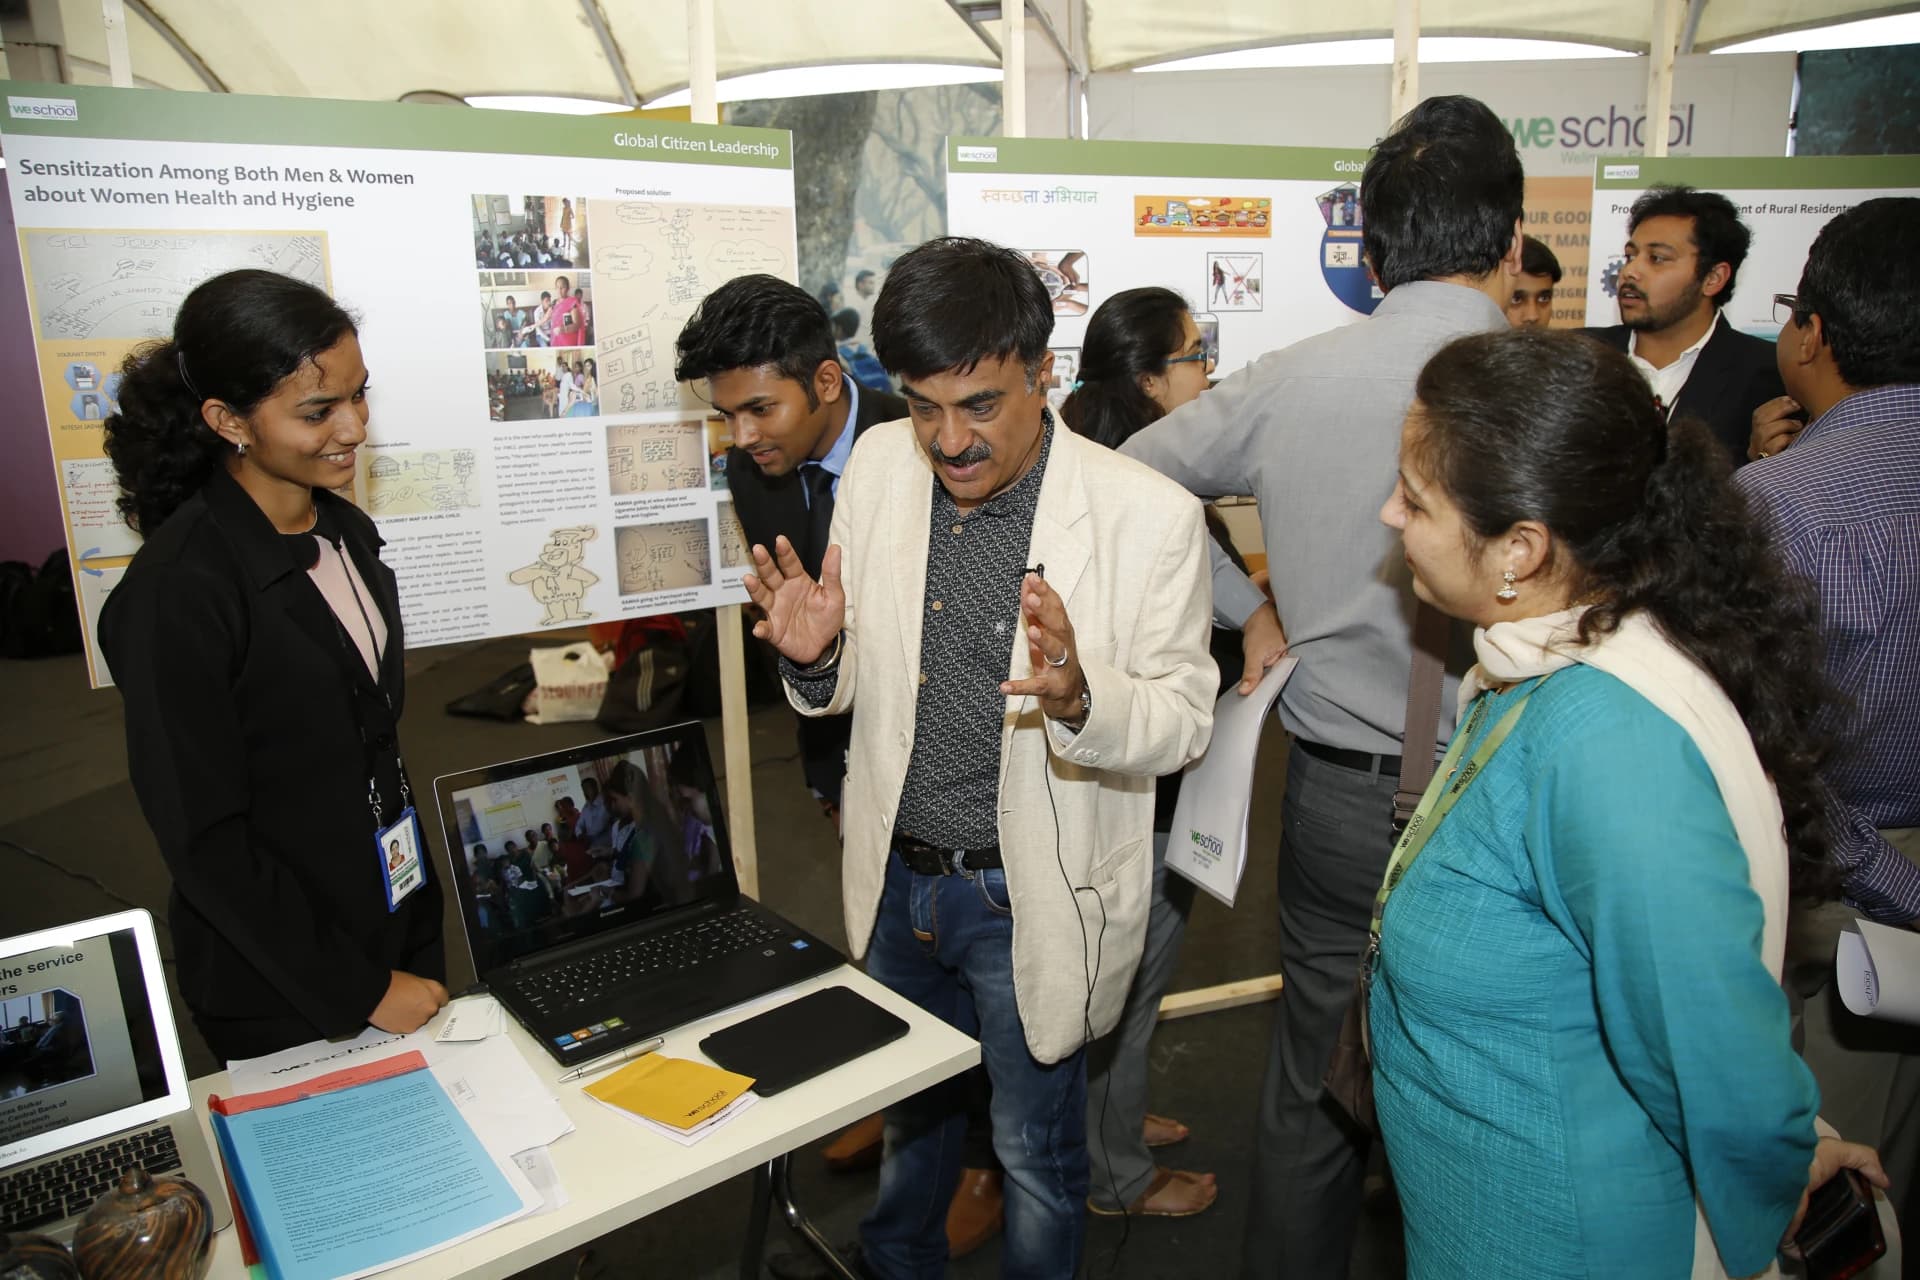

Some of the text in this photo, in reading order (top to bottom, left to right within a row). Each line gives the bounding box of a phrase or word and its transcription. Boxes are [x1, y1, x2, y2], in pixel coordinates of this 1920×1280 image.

[614, 133, 780, 159] Global Citizen Leadership
[20, 158, 414, 186] Sensitization Among Both Men & Women
[1334, 160, 1367, 172] Global
[24, 185, 355, 212] about Women Health and Hygiene
[1042, 186, 1098, 204] अभियान
[1755, 203, 1767, 214] of
[1769, 203, 1797, 214] Rural
[1190, 829, 1224, 857] weschool
[27, 952, 84, 973] service
